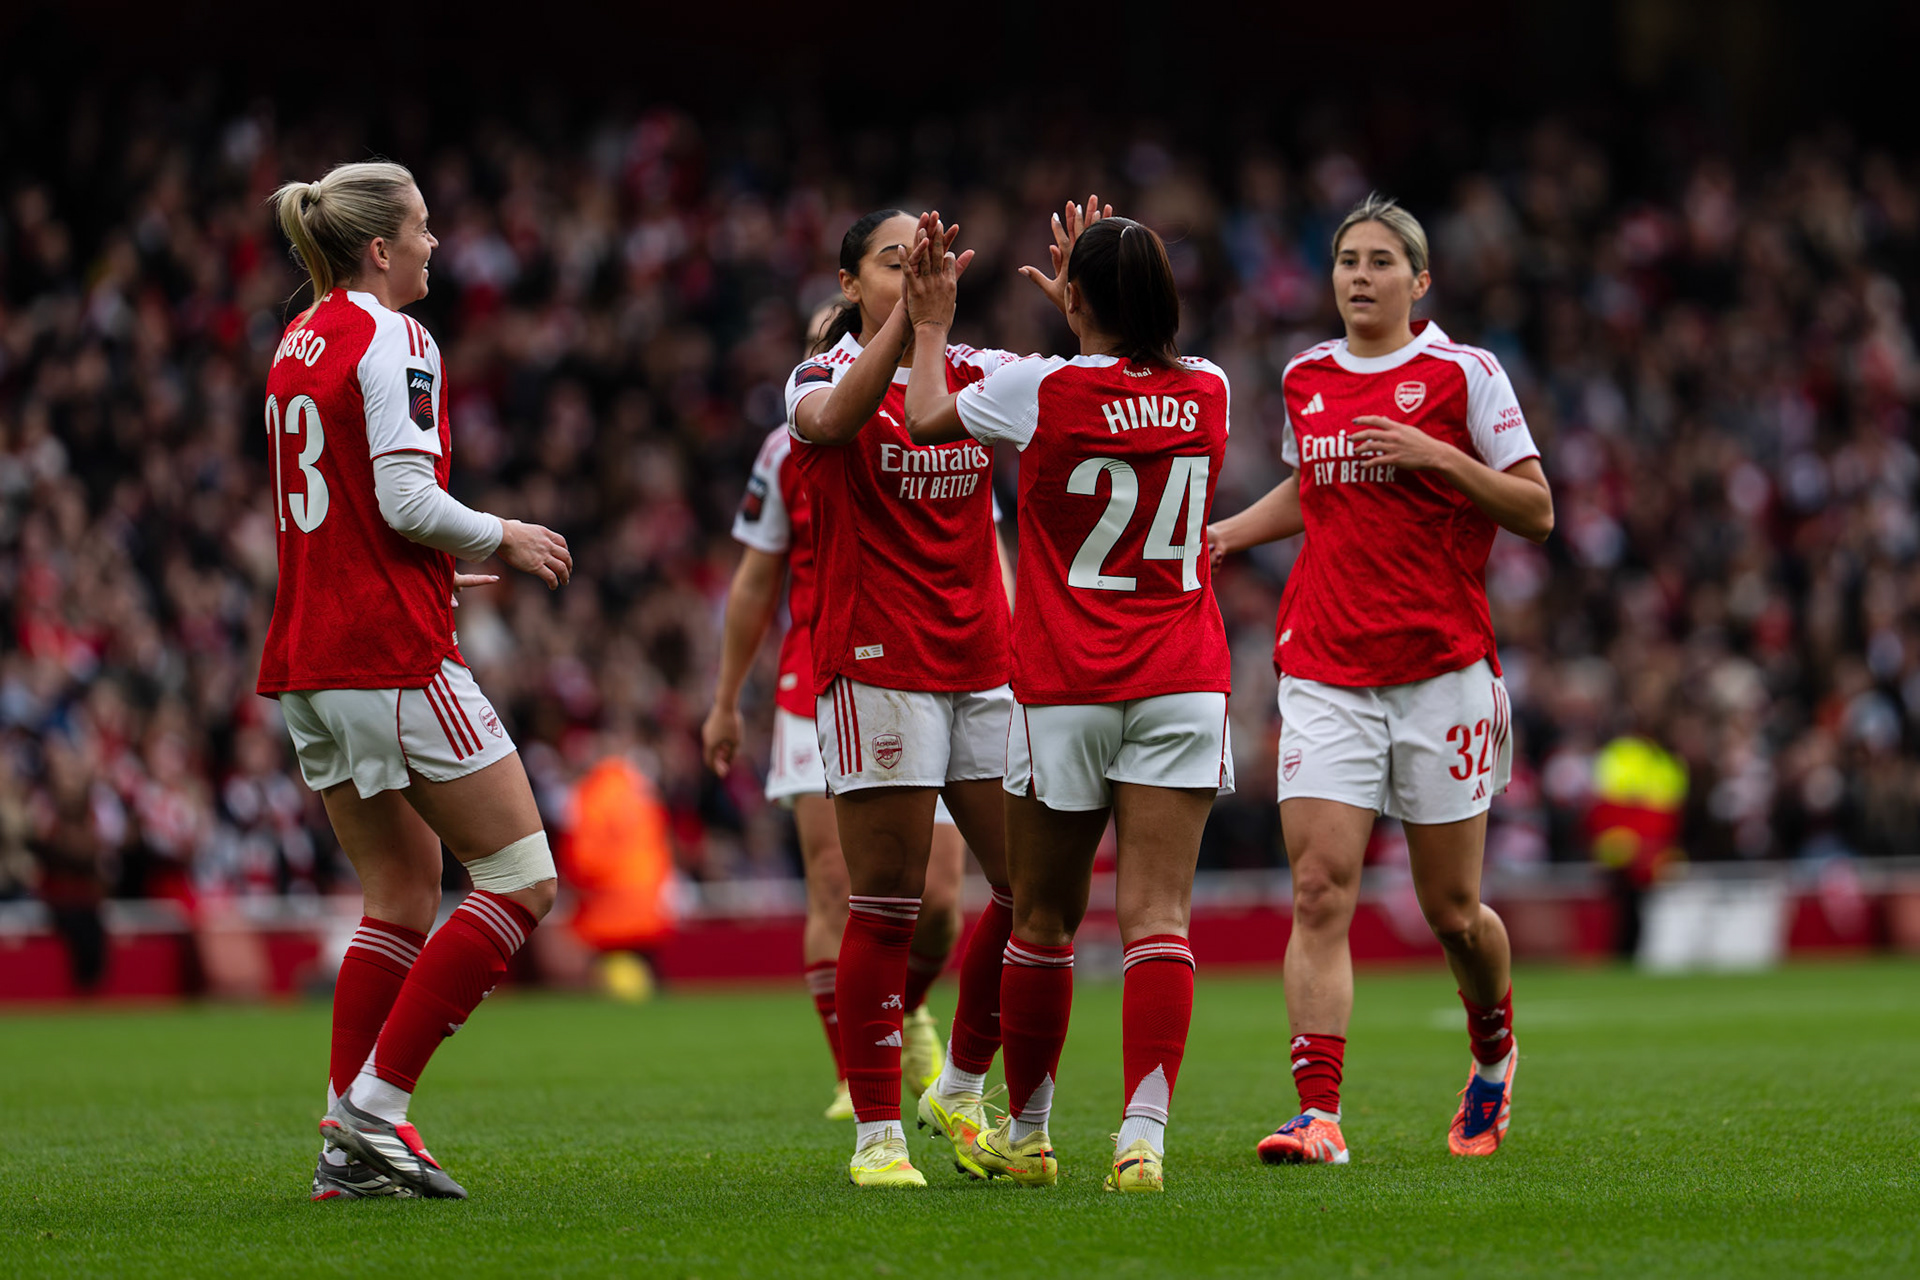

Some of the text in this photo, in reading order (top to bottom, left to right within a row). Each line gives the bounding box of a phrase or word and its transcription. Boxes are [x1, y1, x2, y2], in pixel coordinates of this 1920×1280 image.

[1101, 395, 1199, 435] HINDS
[1498, 405, 1519, 419] VISI
[880, 443, 990, 473] Emirates
[899, 473, 979, 500] FLY BETTER
[1314, 461, 1335, 486] FLY
[1066, 455, 1211, 593] 24
[1445, 718, 1491, 781] 32
